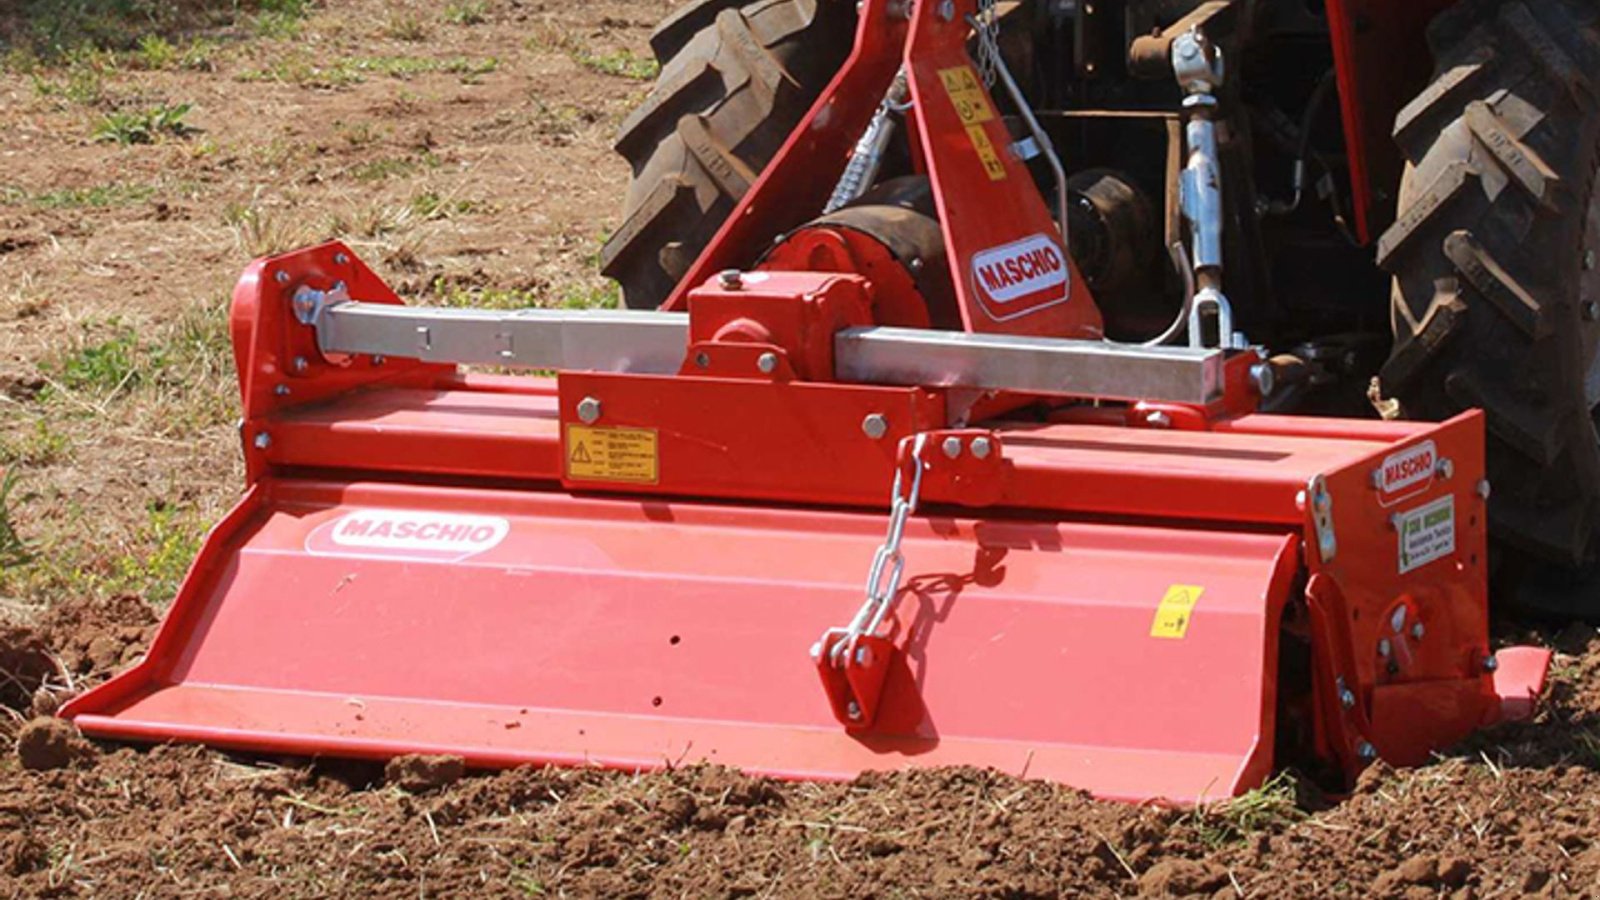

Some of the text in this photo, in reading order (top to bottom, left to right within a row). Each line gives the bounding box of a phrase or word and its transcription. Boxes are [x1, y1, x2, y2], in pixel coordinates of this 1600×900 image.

[979, 247, 1060, 289] MASCHIO
[1386, 452, 1431, 484] MASCHIO
[340, 519, 496, 543] MASCHIO
